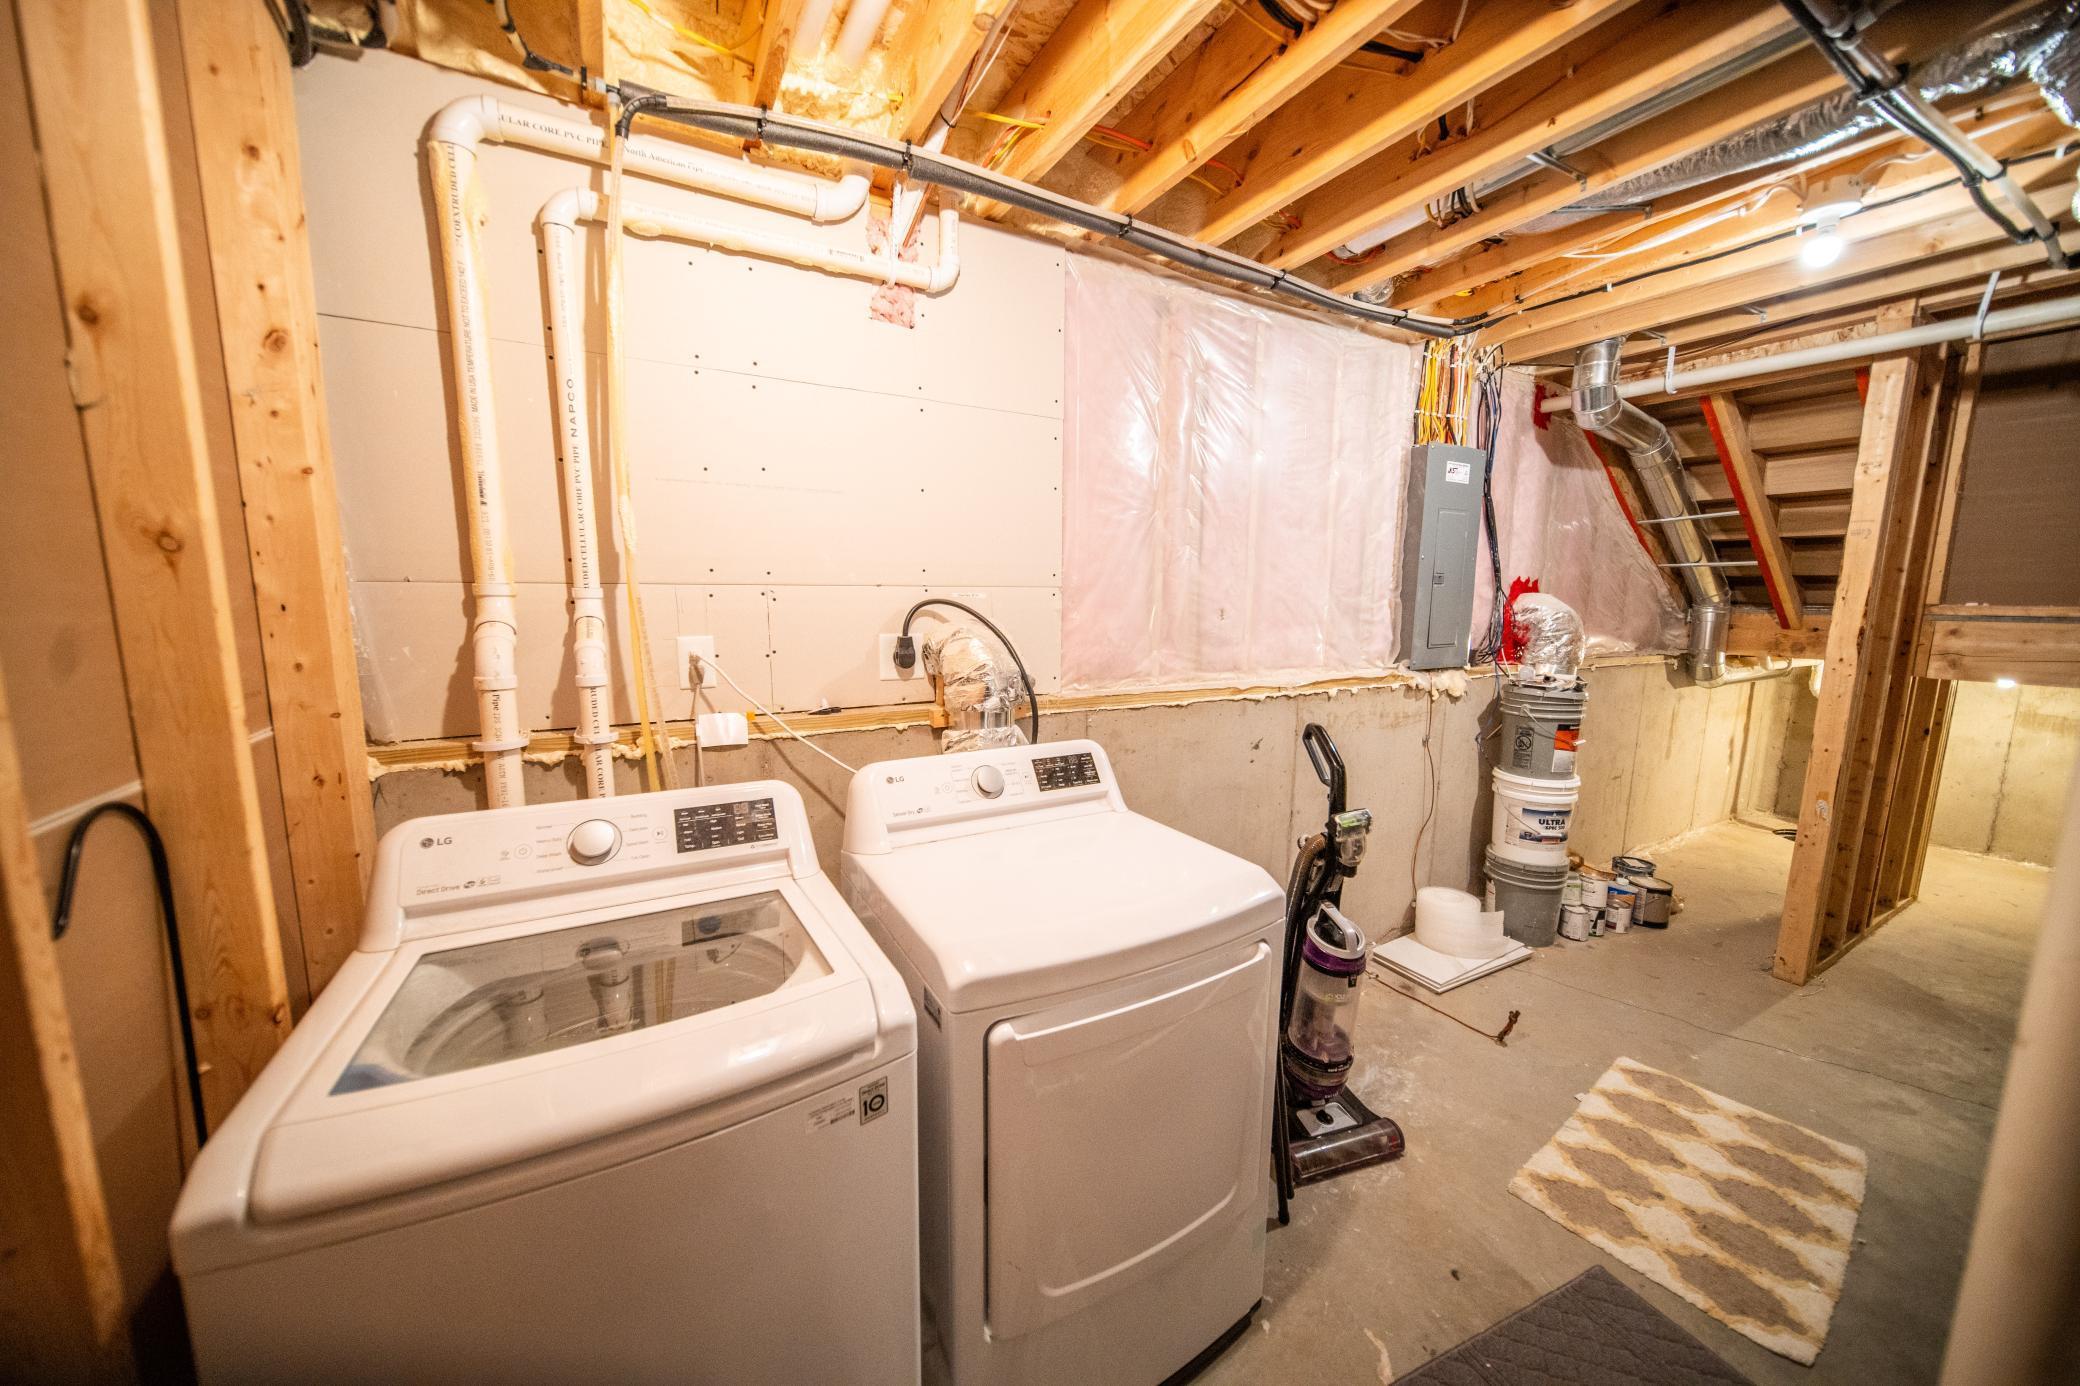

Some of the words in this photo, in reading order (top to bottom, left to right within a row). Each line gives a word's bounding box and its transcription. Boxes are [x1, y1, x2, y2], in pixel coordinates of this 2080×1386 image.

[531, 121, 560, 136] CORE
[563, 130, 583, 141] PVC
[648, 151, 687, 170] American
[450, 169, 462, 238] COEXTRUDED
[458, 277, 468, 305] EXCEED
[465, 326, 474, 372] TEMPERATURE
[468, 374, 476, 388] USA
[471, 395, 479, 413] MADE
[566, 378, 579, 438] NAPCO
[572, 446, 580, 464] PIPE
[573, 467, 582, 484] PVC
[575, 487, 584, 511] CORE
[578, 512, 588, 560] CELLULAR
[596, 766, 607, 791] CORE
[1538, 818, 1565, 826] ULTRA
[436, 836, 453, 846] LG
[863, 1094, 885, 1116] 10
